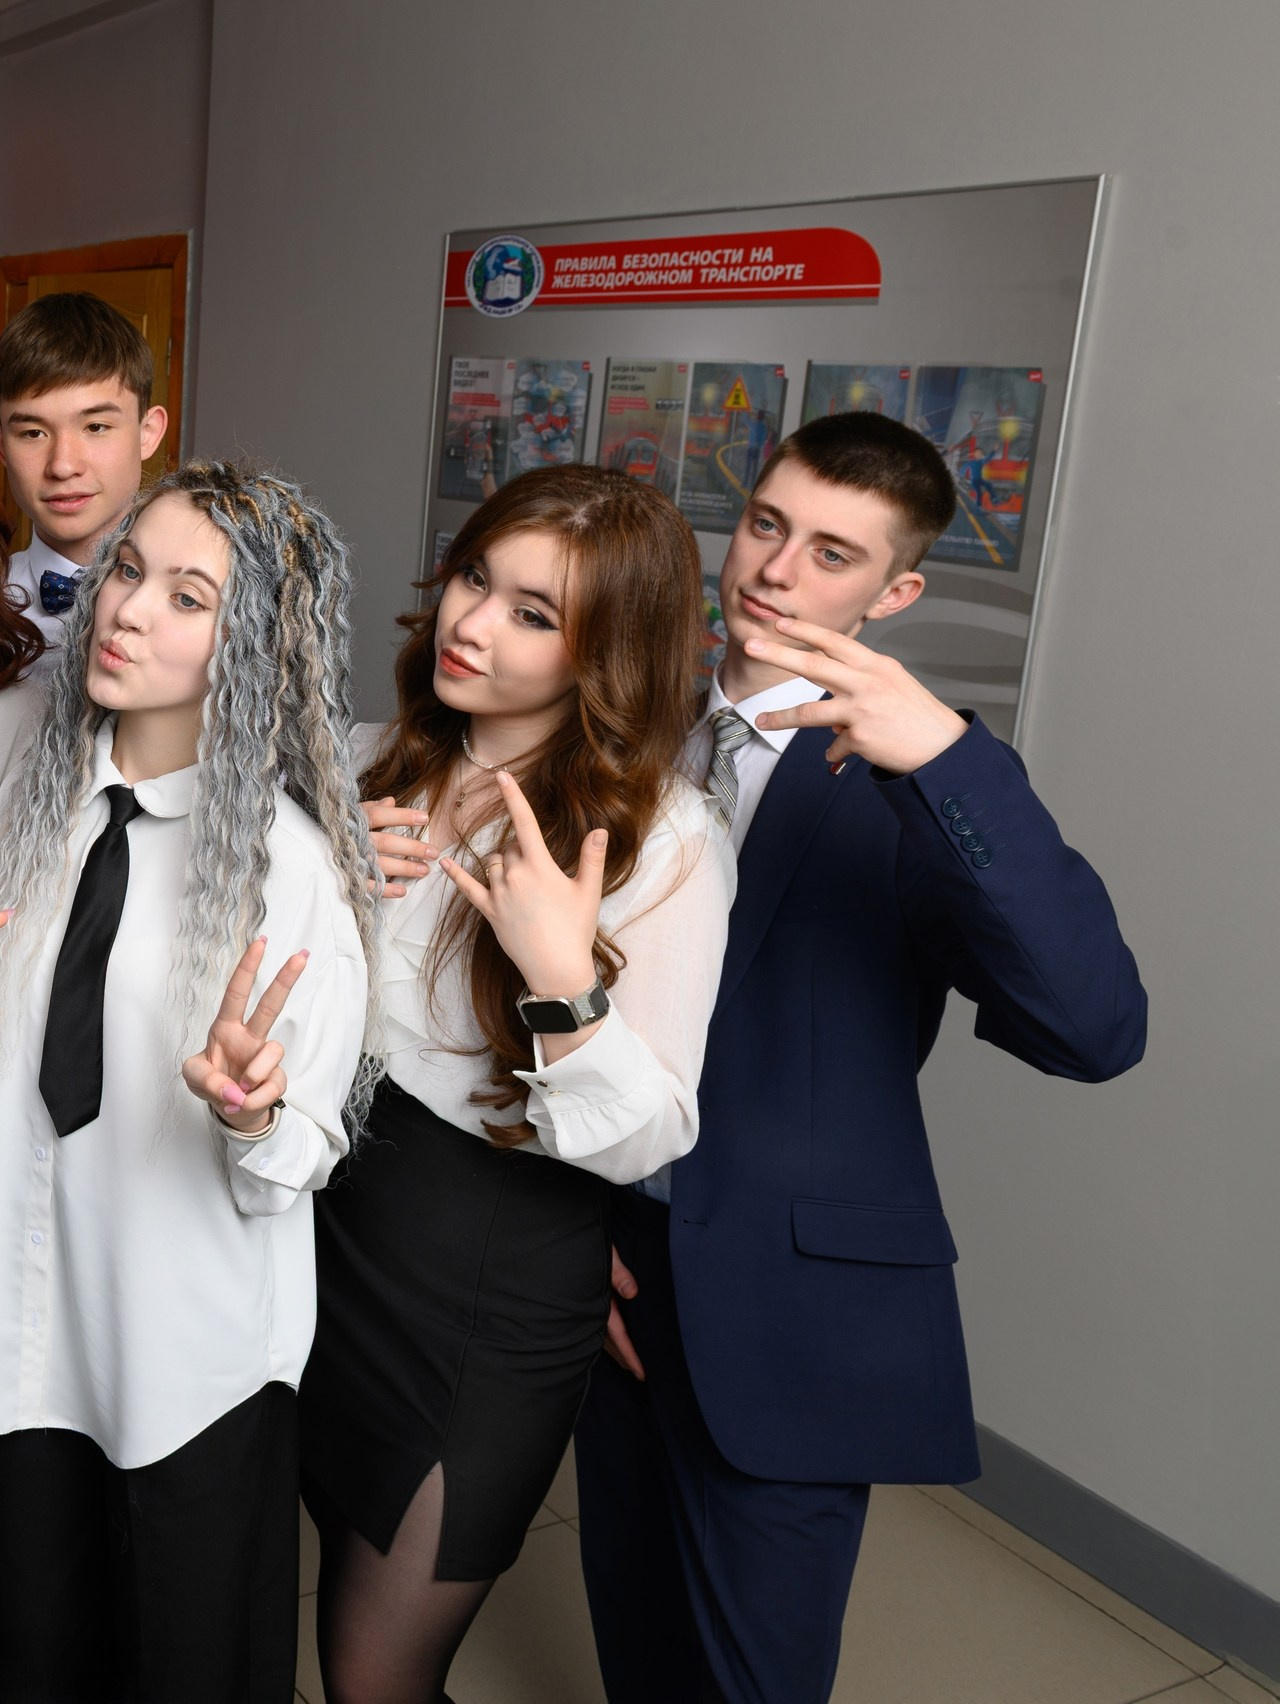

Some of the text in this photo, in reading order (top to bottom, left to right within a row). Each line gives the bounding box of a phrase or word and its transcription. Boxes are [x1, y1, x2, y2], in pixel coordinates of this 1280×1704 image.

[554, 246, 774, 272] ПРАВИЛА БЕЗОПАСНОСТИ НА
[551, 263, 805, 289] ЖЕЛЕЗОДОРОЖНОМ ТРАНСПОРТЕ
